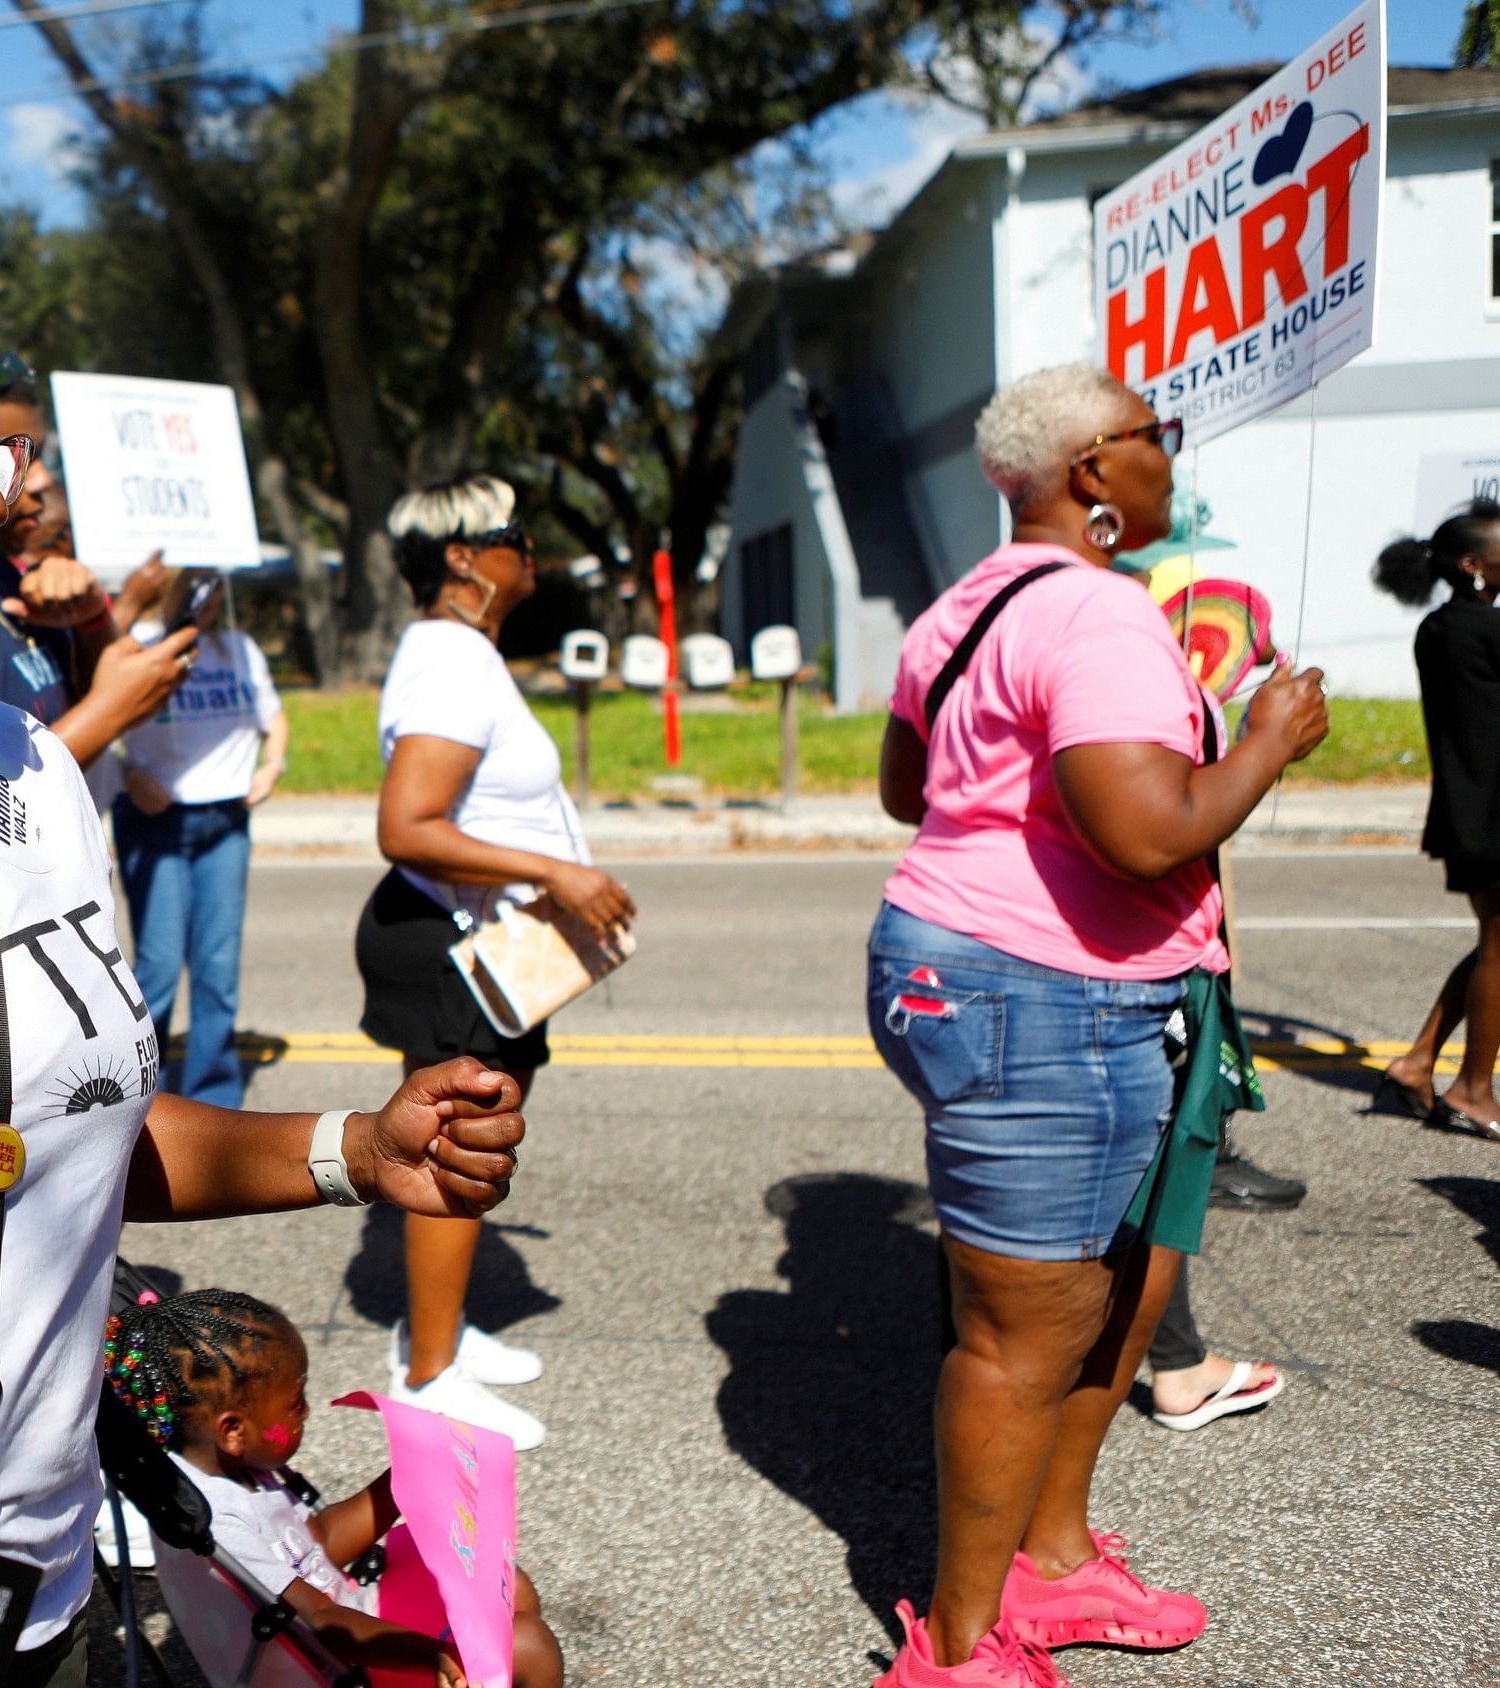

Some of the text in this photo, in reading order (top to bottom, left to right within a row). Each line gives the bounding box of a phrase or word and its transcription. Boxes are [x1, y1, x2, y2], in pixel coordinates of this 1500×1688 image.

[1107, 21, 1366, 232] RE-ELECT Ms. DEE
[1106, 157, 1246, 289] DIANNE
[1107, 122, 1369, 385] HART
[1168, 332, 1261, 402] STATE
[1272, 260, 1366, 349] HOUSE
[1274, 349, 1296, 378] 63
[13, 795, 27, 845] WALZ
